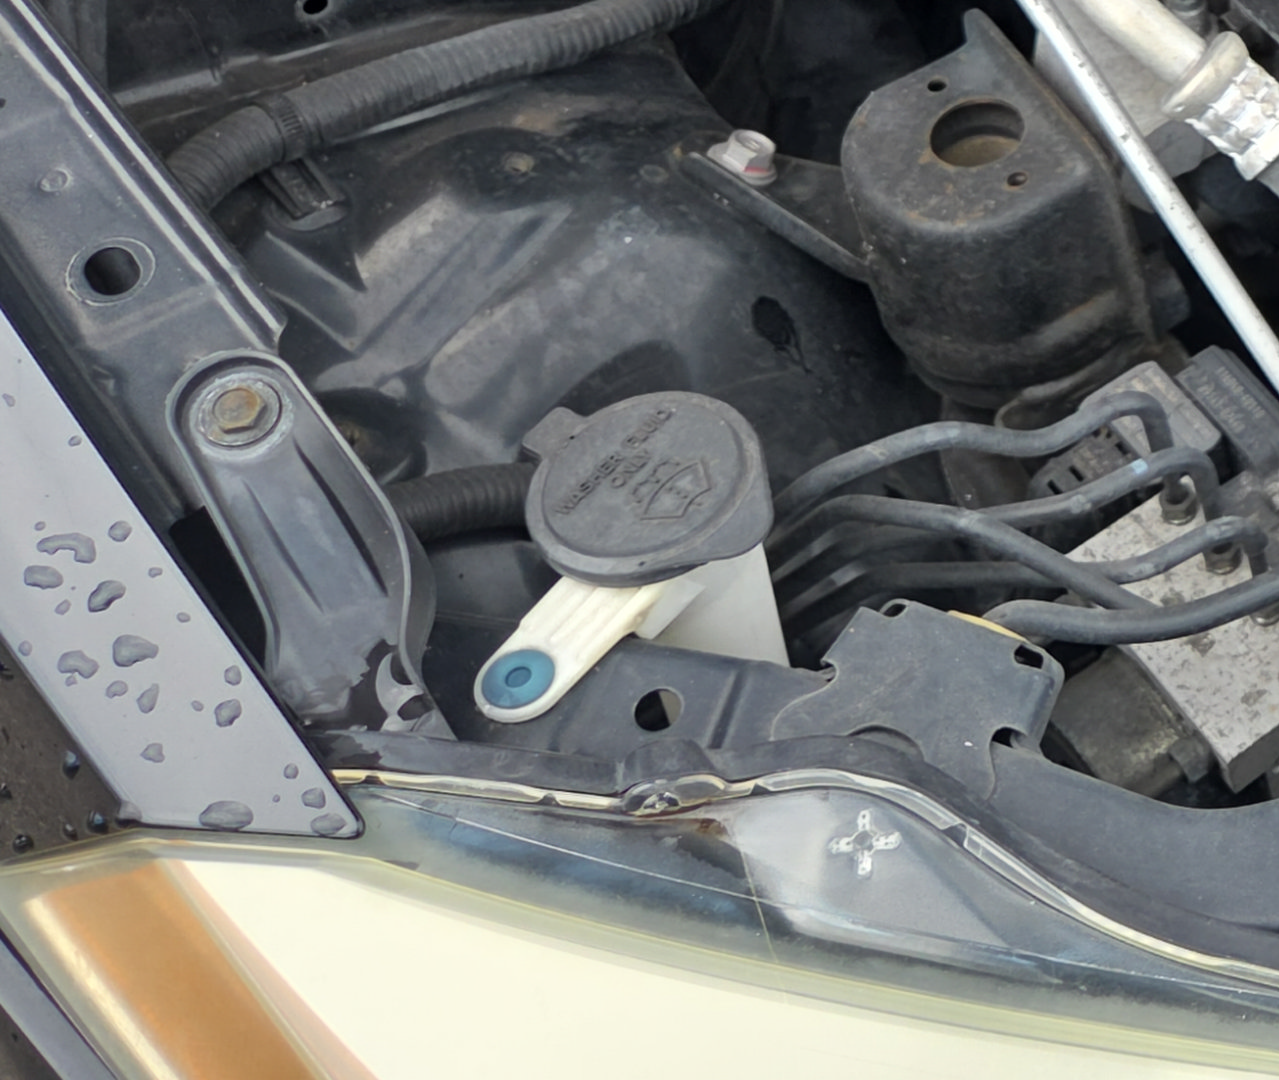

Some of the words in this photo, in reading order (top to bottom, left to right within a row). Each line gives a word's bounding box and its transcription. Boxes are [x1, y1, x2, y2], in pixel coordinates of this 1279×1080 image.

[556, 450, 624, 515] WASHER
[622, 408, 675, 448] FLUID
[610, 450, 651, 489] ONLY
